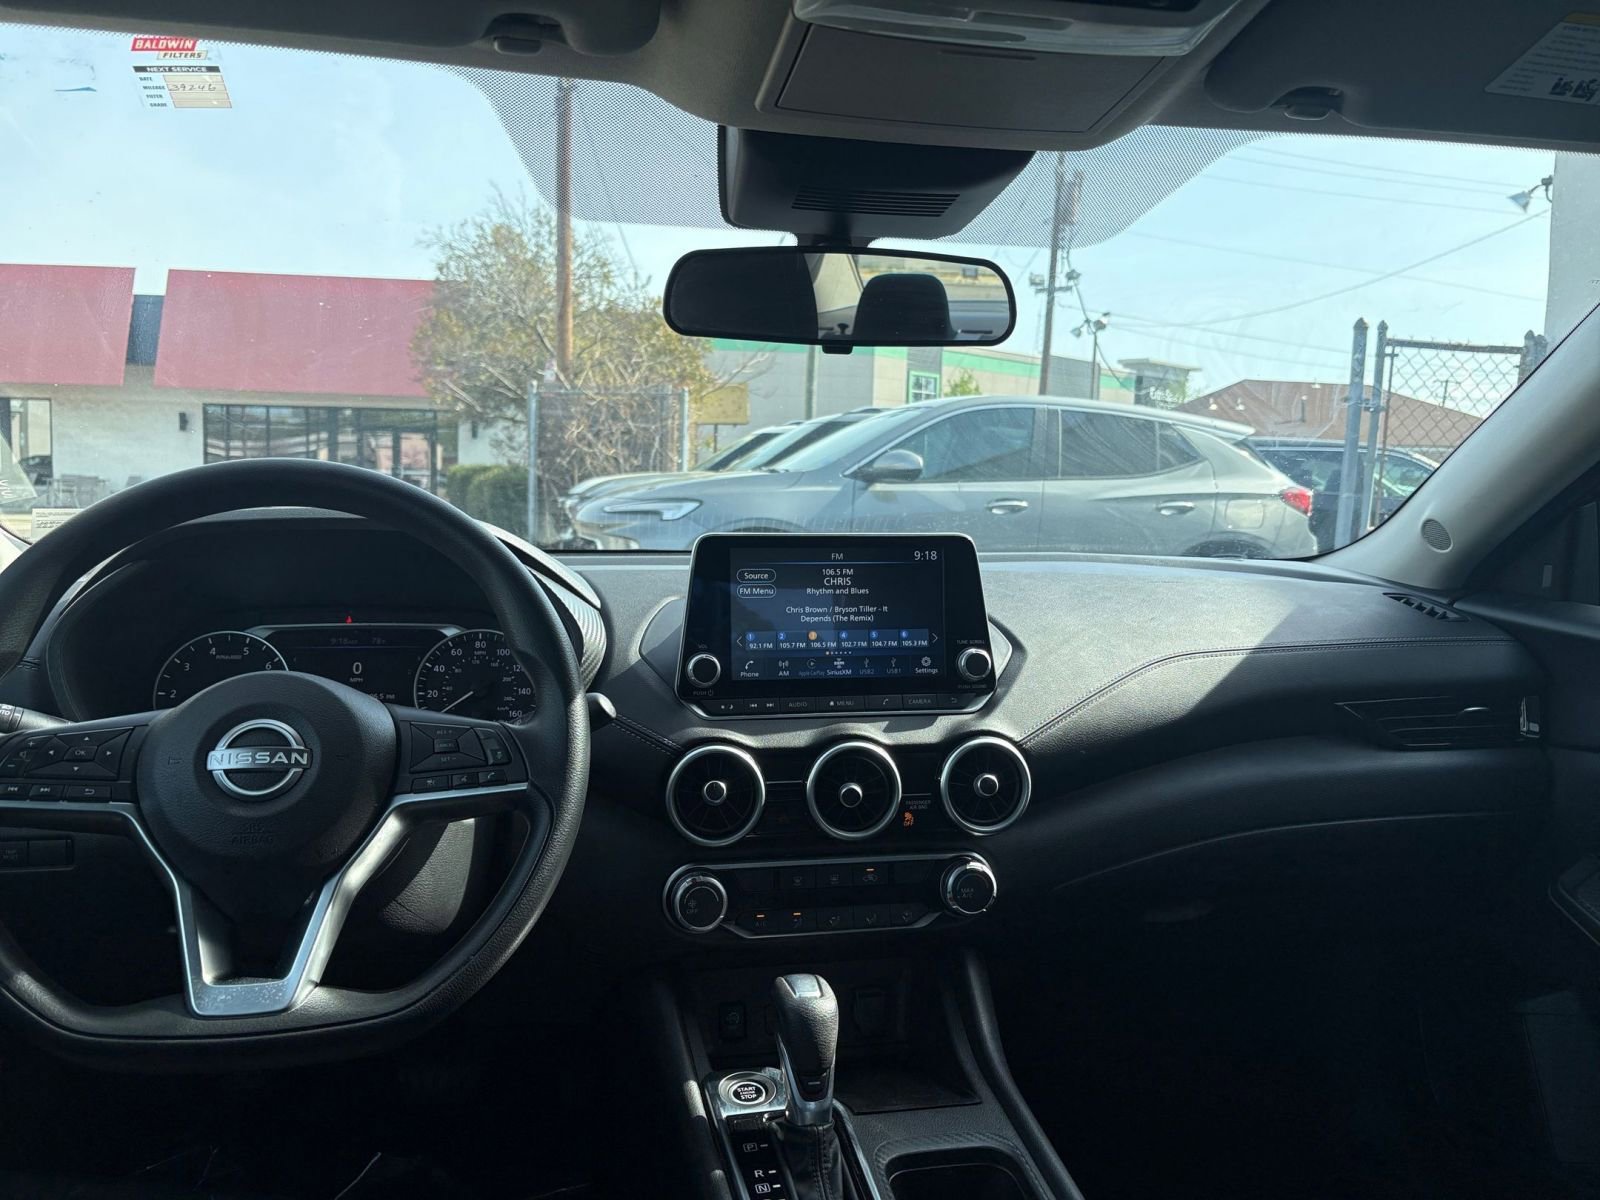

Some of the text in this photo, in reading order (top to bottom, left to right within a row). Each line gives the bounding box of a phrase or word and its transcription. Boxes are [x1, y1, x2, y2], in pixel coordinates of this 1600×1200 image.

[134, 39, 194, 49] BALDWIN
[914, 551, 938, 561] 9:18
[822, 568, 841, 576] 106.5
[823, 577, 852, 586] CHRIS
[806, 587, 834, 596] Rhythm
[835, 587, 849, 595] and
[834, 606, 858, 614] Bryson
[800, 614, 874, 623] Depends (The Remix)
[474, 640, 487, 648] 80
[209, 647, 216, 656] 4
[242, 647, 250, 656] 5
[450, 648, 463, 656] 60
[496, 648, 511, 656] 100
[183, 662, 190, 671] 3
[265, 661, 272, 670] 6
[352, 661, 363, 675] 0
[433, 664, 446, 673] 40
[915, 667, 939, 675] Settings
[169, 689, 177, 698] 2
[426, 690, 439, 698] 20
[508, 710, 523, 718] 160
[209, 751, 308, 765] NISSAN
[754, 1169, 765, 1178] R
